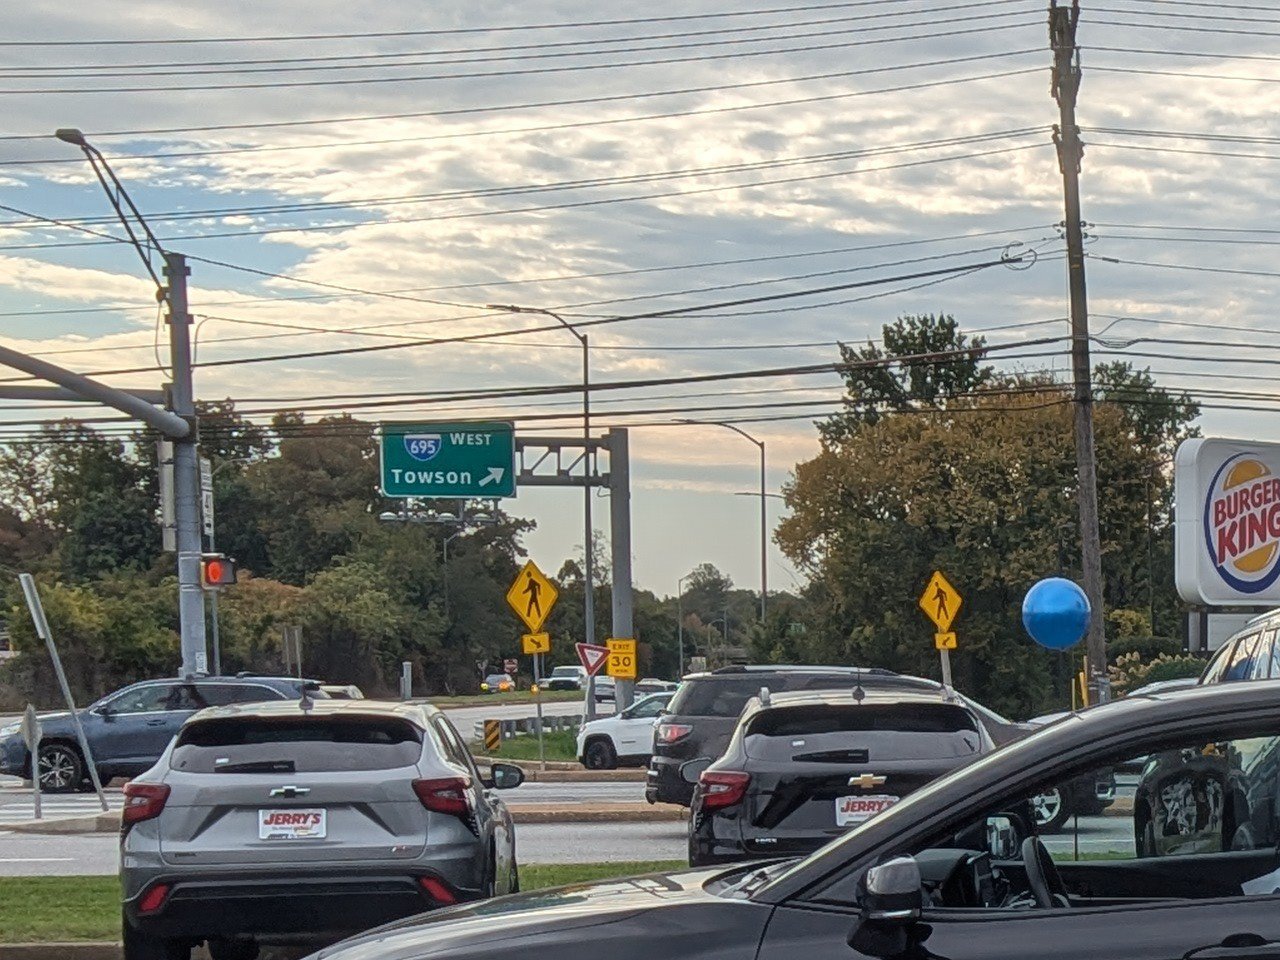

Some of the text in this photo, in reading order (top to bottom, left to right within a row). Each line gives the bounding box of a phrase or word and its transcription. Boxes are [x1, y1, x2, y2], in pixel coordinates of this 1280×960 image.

[410, 440, 436, 454] 695
[390, 468, 471, 485] Towson
[611, 656, 632, 667] 30
[263, 812, 322, 826] JERRY'S
